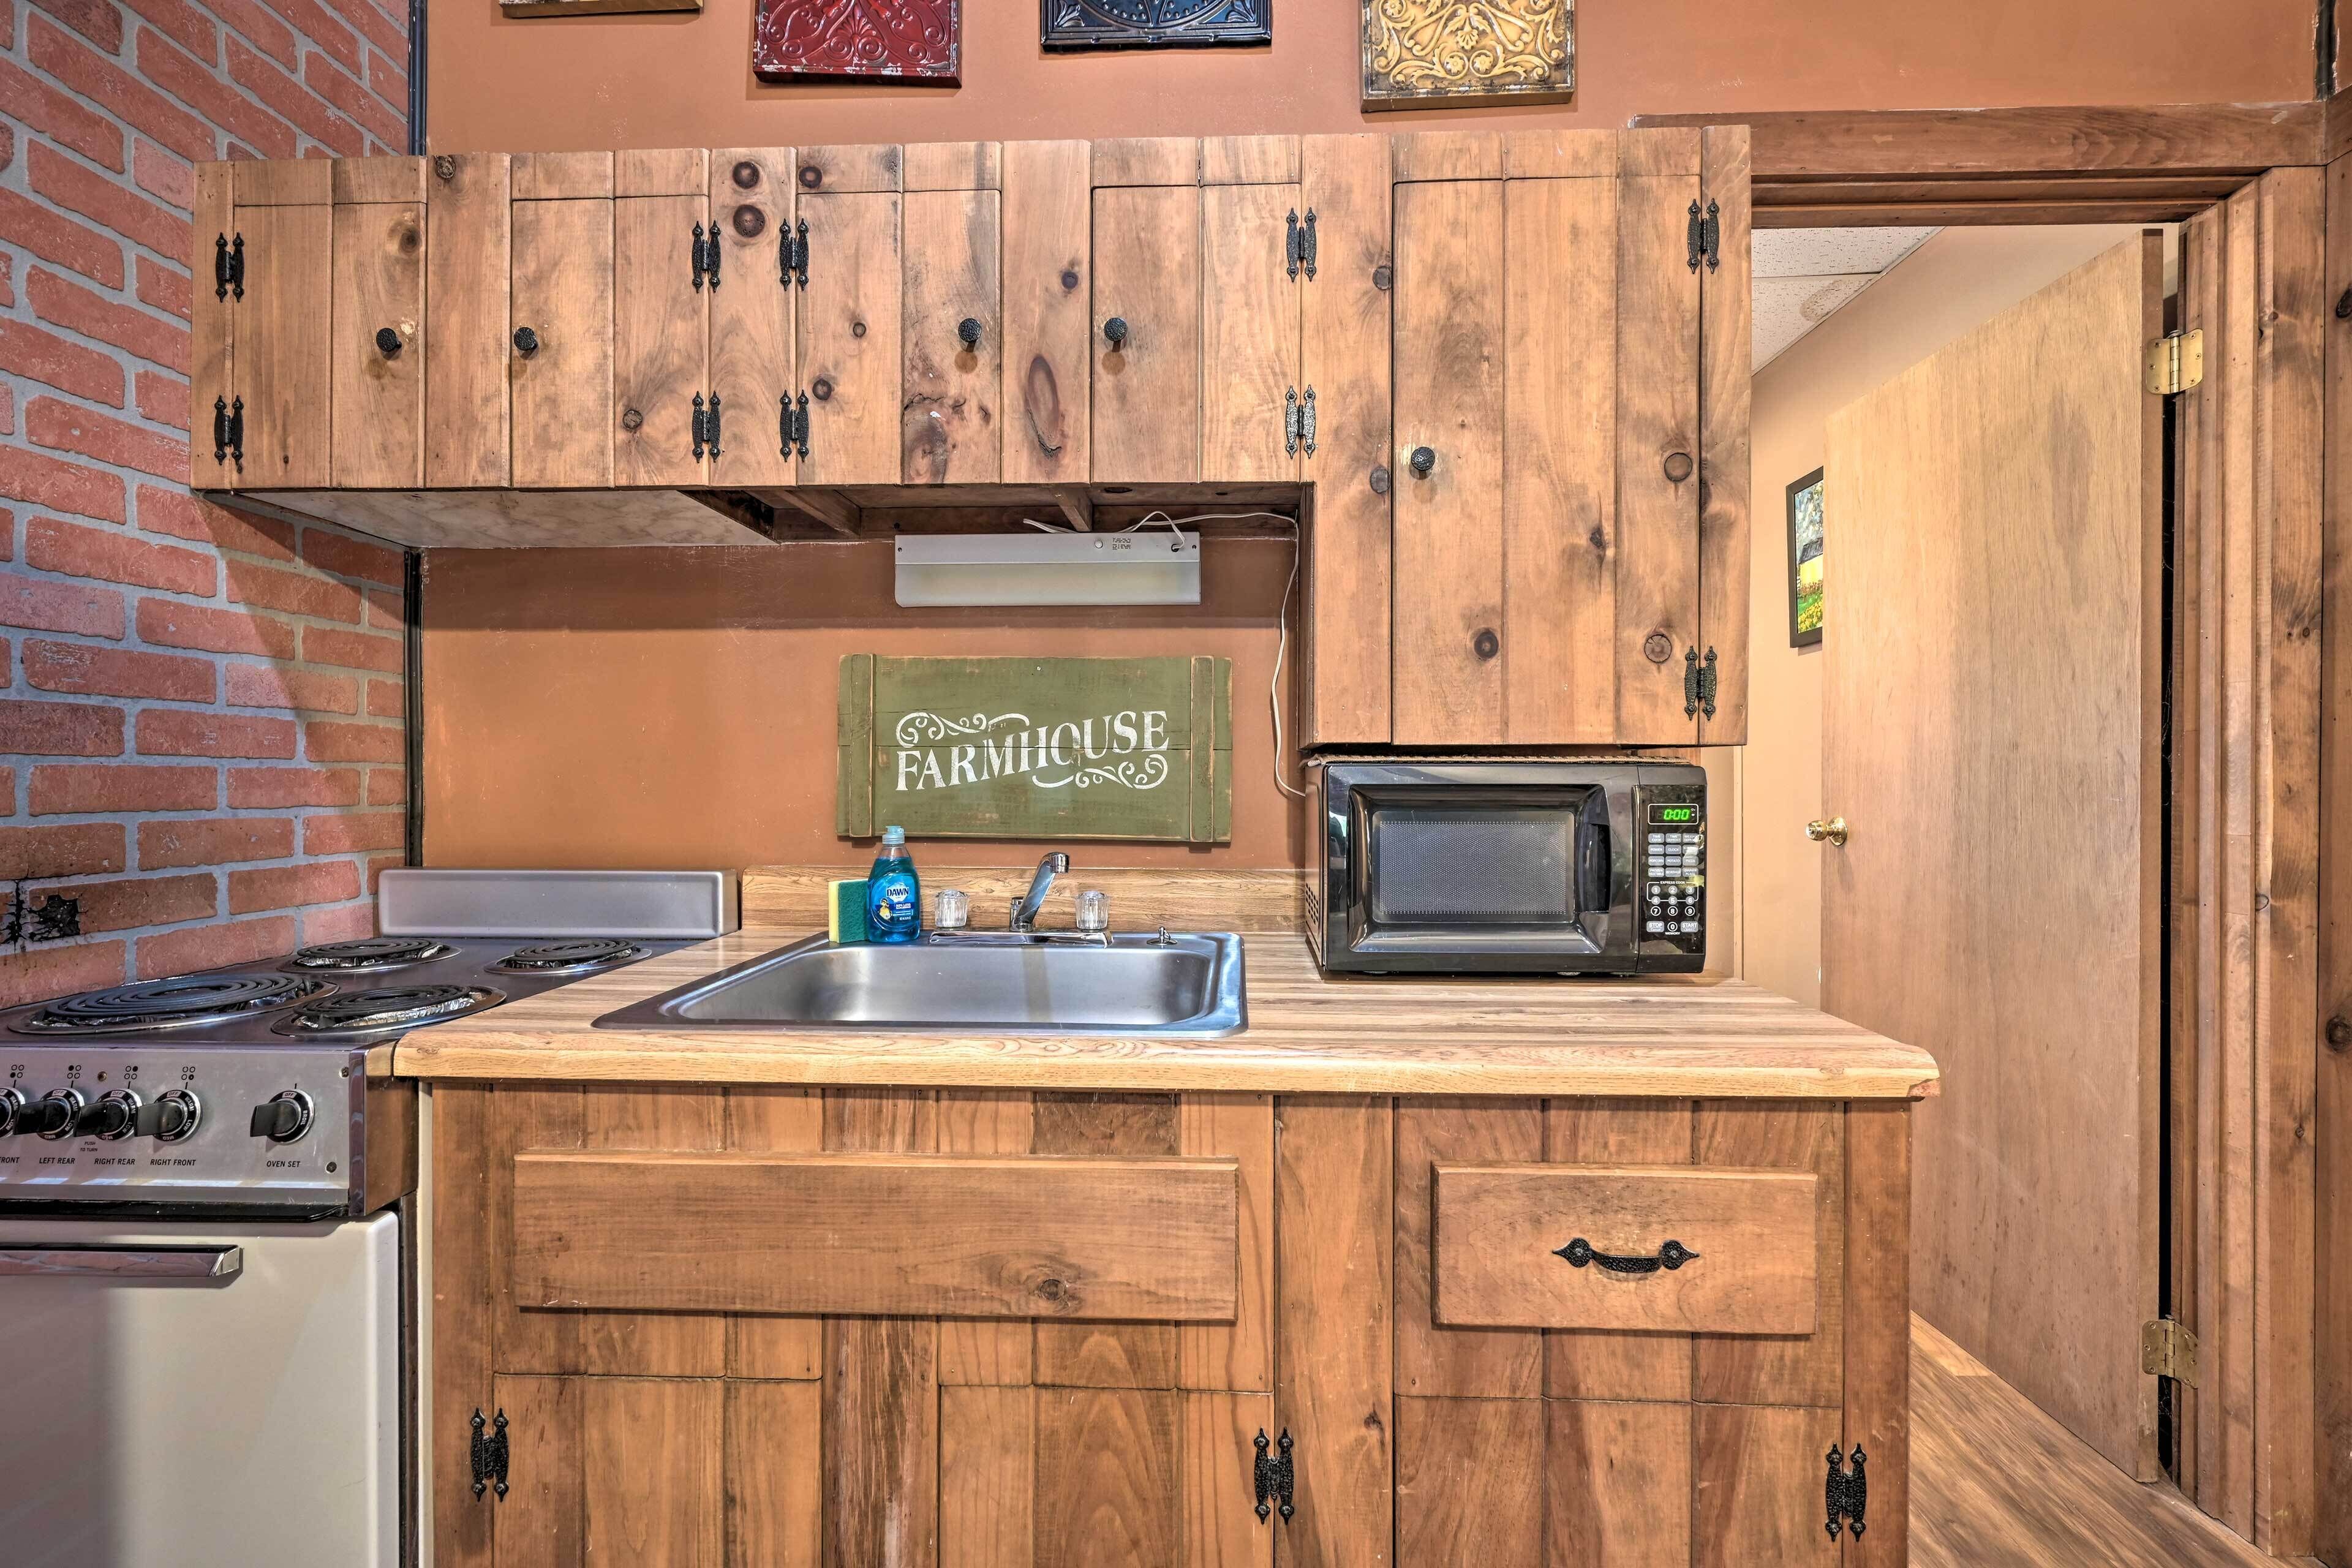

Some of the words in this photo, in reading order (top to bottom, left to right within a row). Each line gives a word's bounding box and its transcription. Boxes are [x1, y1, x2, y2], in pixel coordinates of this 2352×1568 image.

[895, 710, 1169, 791] FARMHOUSE
[1664, 809, 1690, 820] 0:00
[886, 888, 909, 897] DAWN
[69, 1096, 78, 1112] WARM
[127, 1098, 137, 1114] WARM
[184, 1096, 195, 1112] WARM
[122, 1121, 133, 1133] LOW
[183, 1119, 193, 1131] LOW
